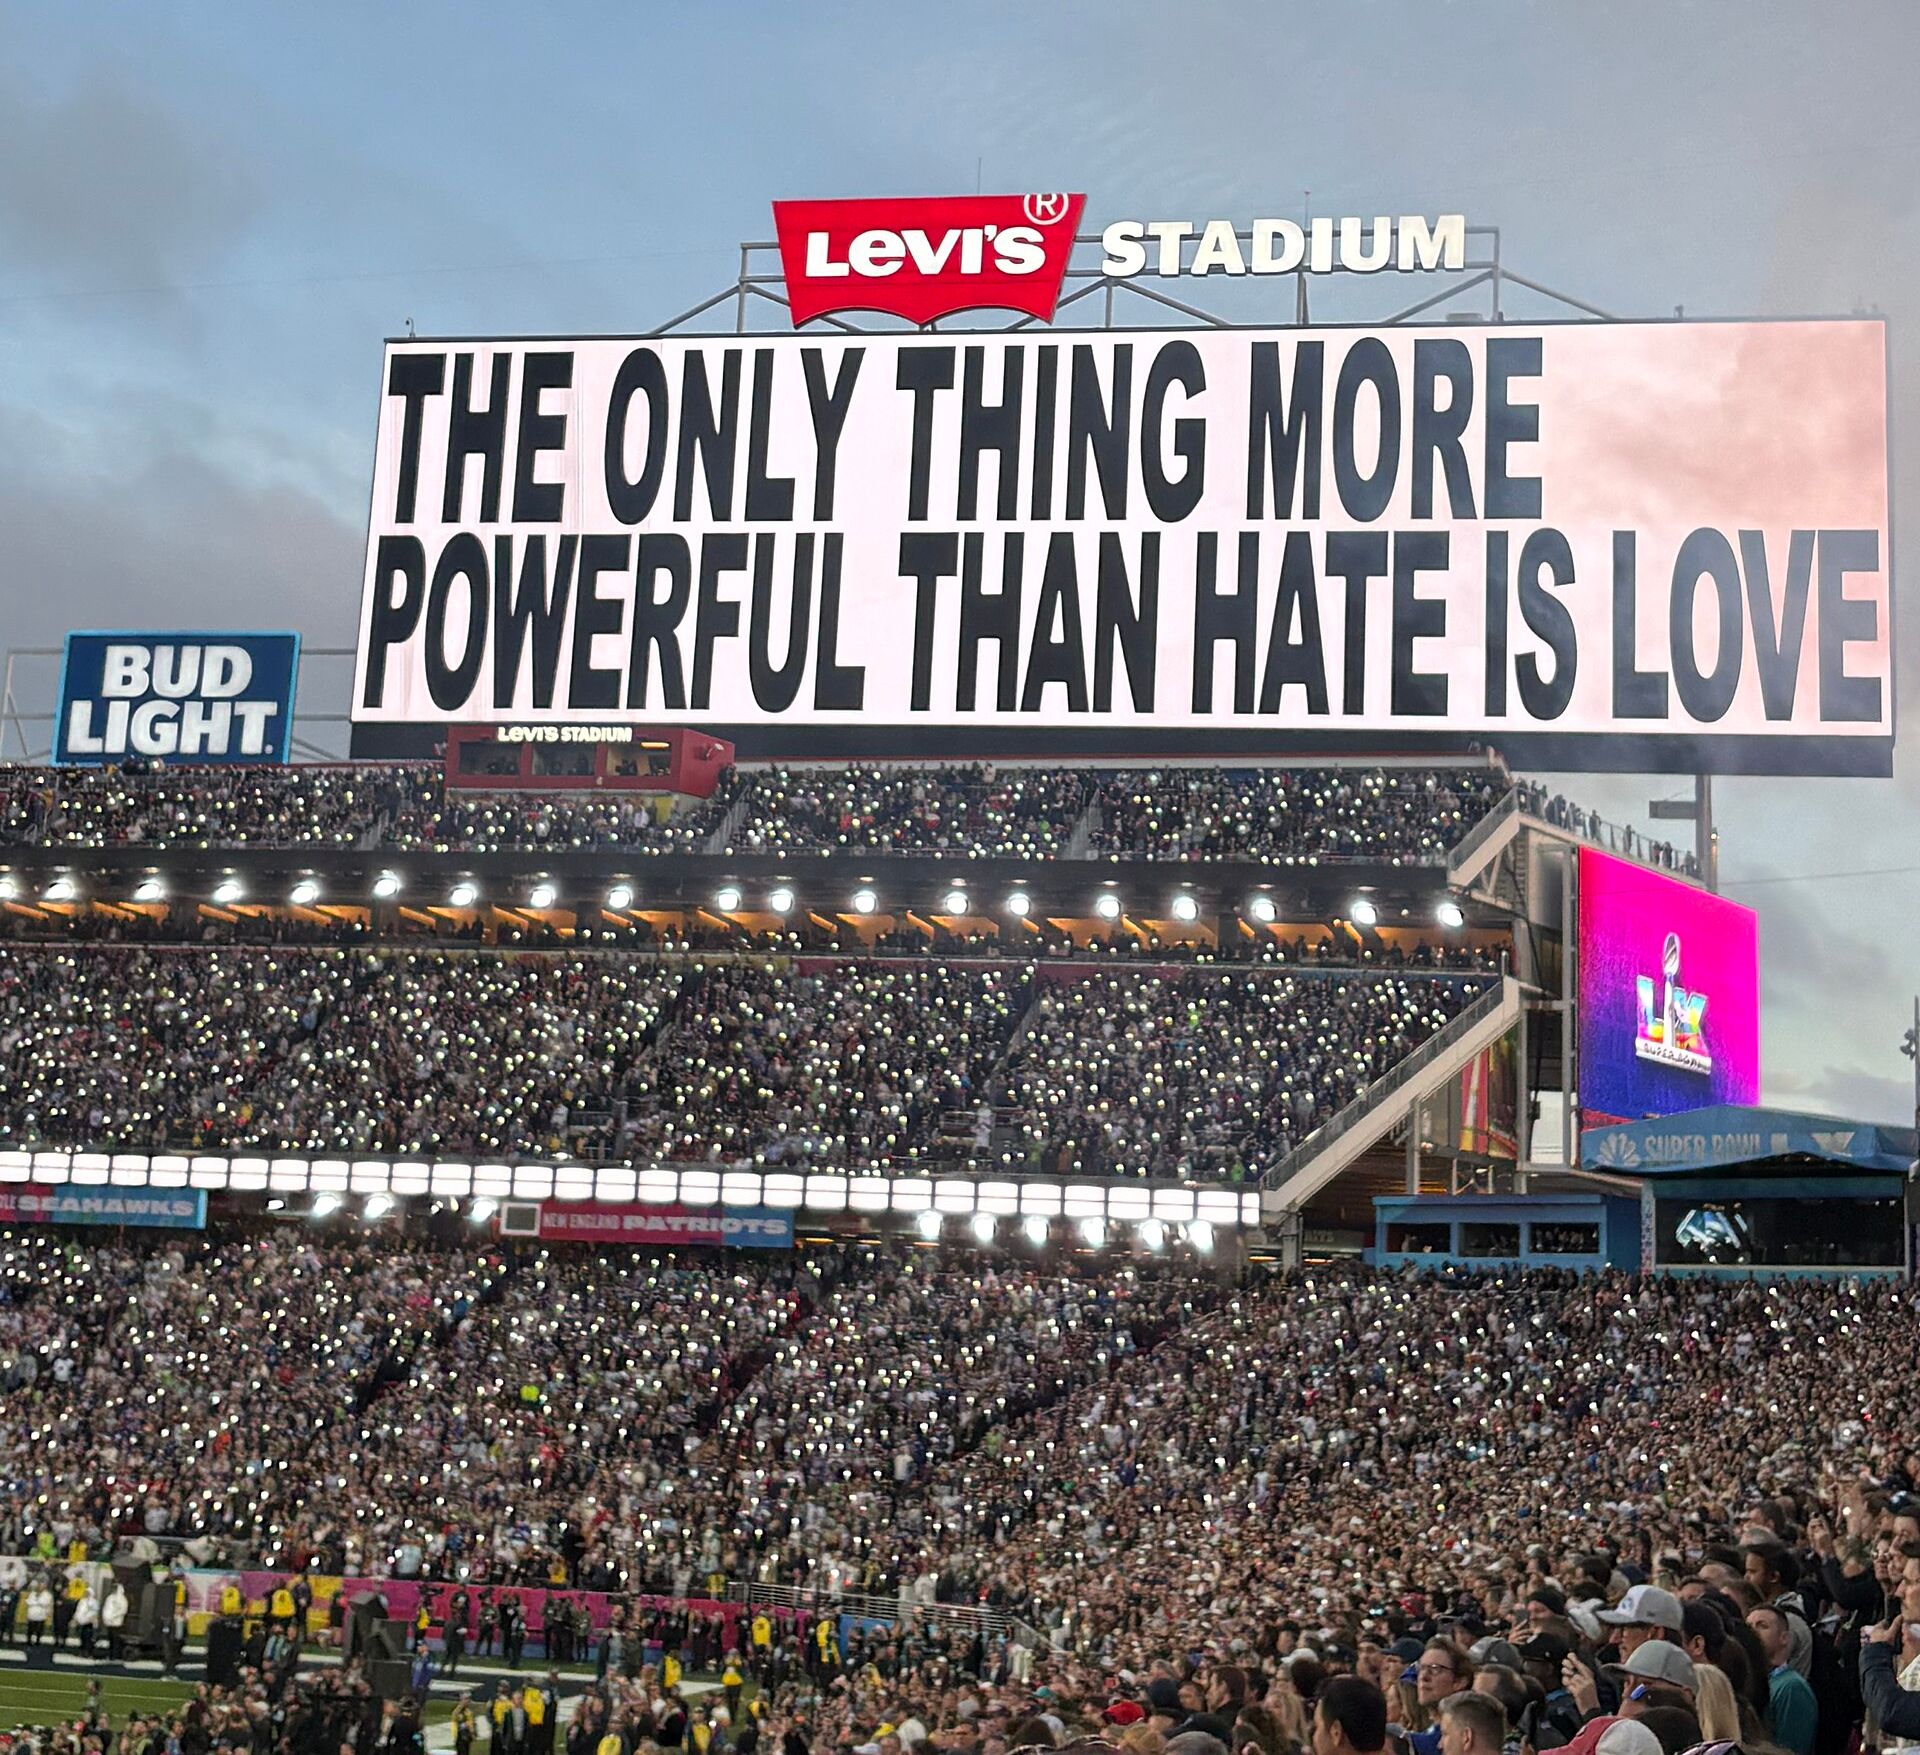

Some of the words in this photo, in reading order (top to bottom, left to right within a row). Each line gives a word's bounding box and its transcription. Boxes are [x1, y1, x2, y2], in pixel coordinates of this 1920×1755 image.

[1101, 214, 1466, 277] STADIUM
[387, 351, 575, 524] THE
[604, 347, 867, 526] ONLY
[895, 339, 1207, 524] THING
[1245, 336, 1543, 523] MORE
[362, 531, 866, 715] POWERFUL
[897, 531, 1162, 714] THAN
[1191, 530, 1450, 717] HATE
[1484, 527, 1578, 721] IS
[1612, 527, 1883, 723] LOVE
[101, 645, 253, 698] BUD
[66, 699, 278, 755] LIGHT
[561, 726, 633, 742] STADIUM
[1644, 1134, 1706, 1161] SUPER
[18, 1194, 194, 1217] SEAHAWKS
[543, 1213, 568, 1228] NEW
[569, 1213, 620, 1230] ENGLAND
[623, 1214, 788, 1235] PATRIOTS
